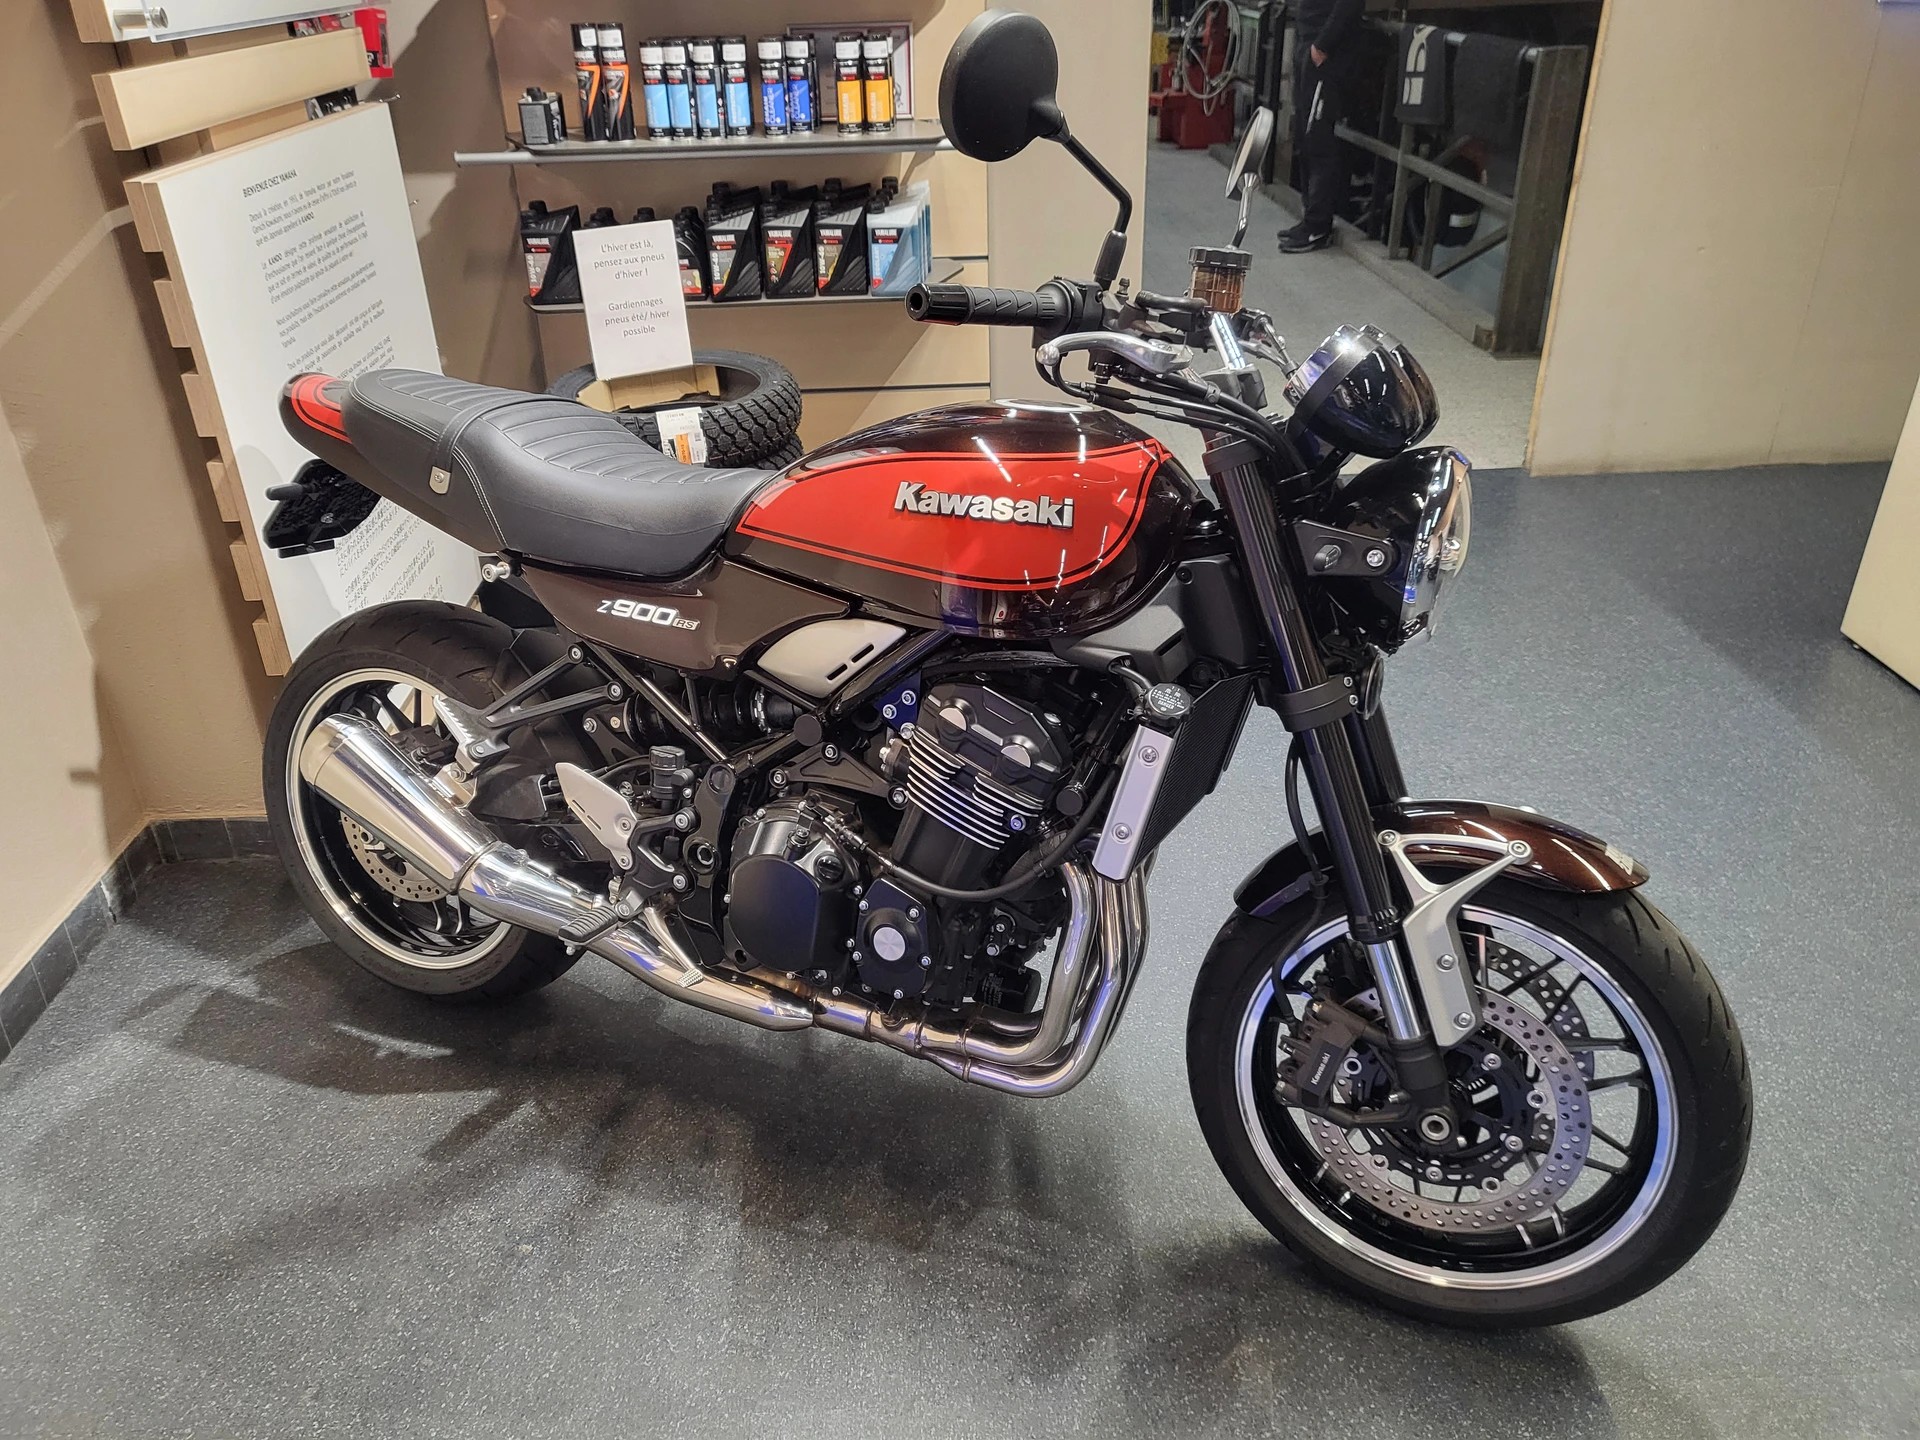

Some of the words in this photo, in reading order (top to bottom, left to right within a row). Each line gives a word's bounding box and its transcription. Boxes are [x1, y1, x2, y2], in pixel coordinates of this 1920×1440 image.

[243, 180, 268, 197] BIENVENUE
[268, 176, 280, 187] CHEZ
[279, 169, 297, 182] YAMAHA
[601, 242, 627, 253] L'hiver
[644, 239, 654, 249] là,
[594, 259, 622, 270] pensez
[641, 253, 664, 264] pneus
[615, 270, 642, 279] d'hiver
[608, 297, 663, 311] Gardiennages
[605, 315, 629, 326] pneus
[631, 311, 648, 322] été/
[650, 309, 670, 319] hiver
[623, 325, 656, 338] possible
[894, 481, 1073, 529] Kawasaki
[1311, 1052, 1331, 1085] Kawasaki
